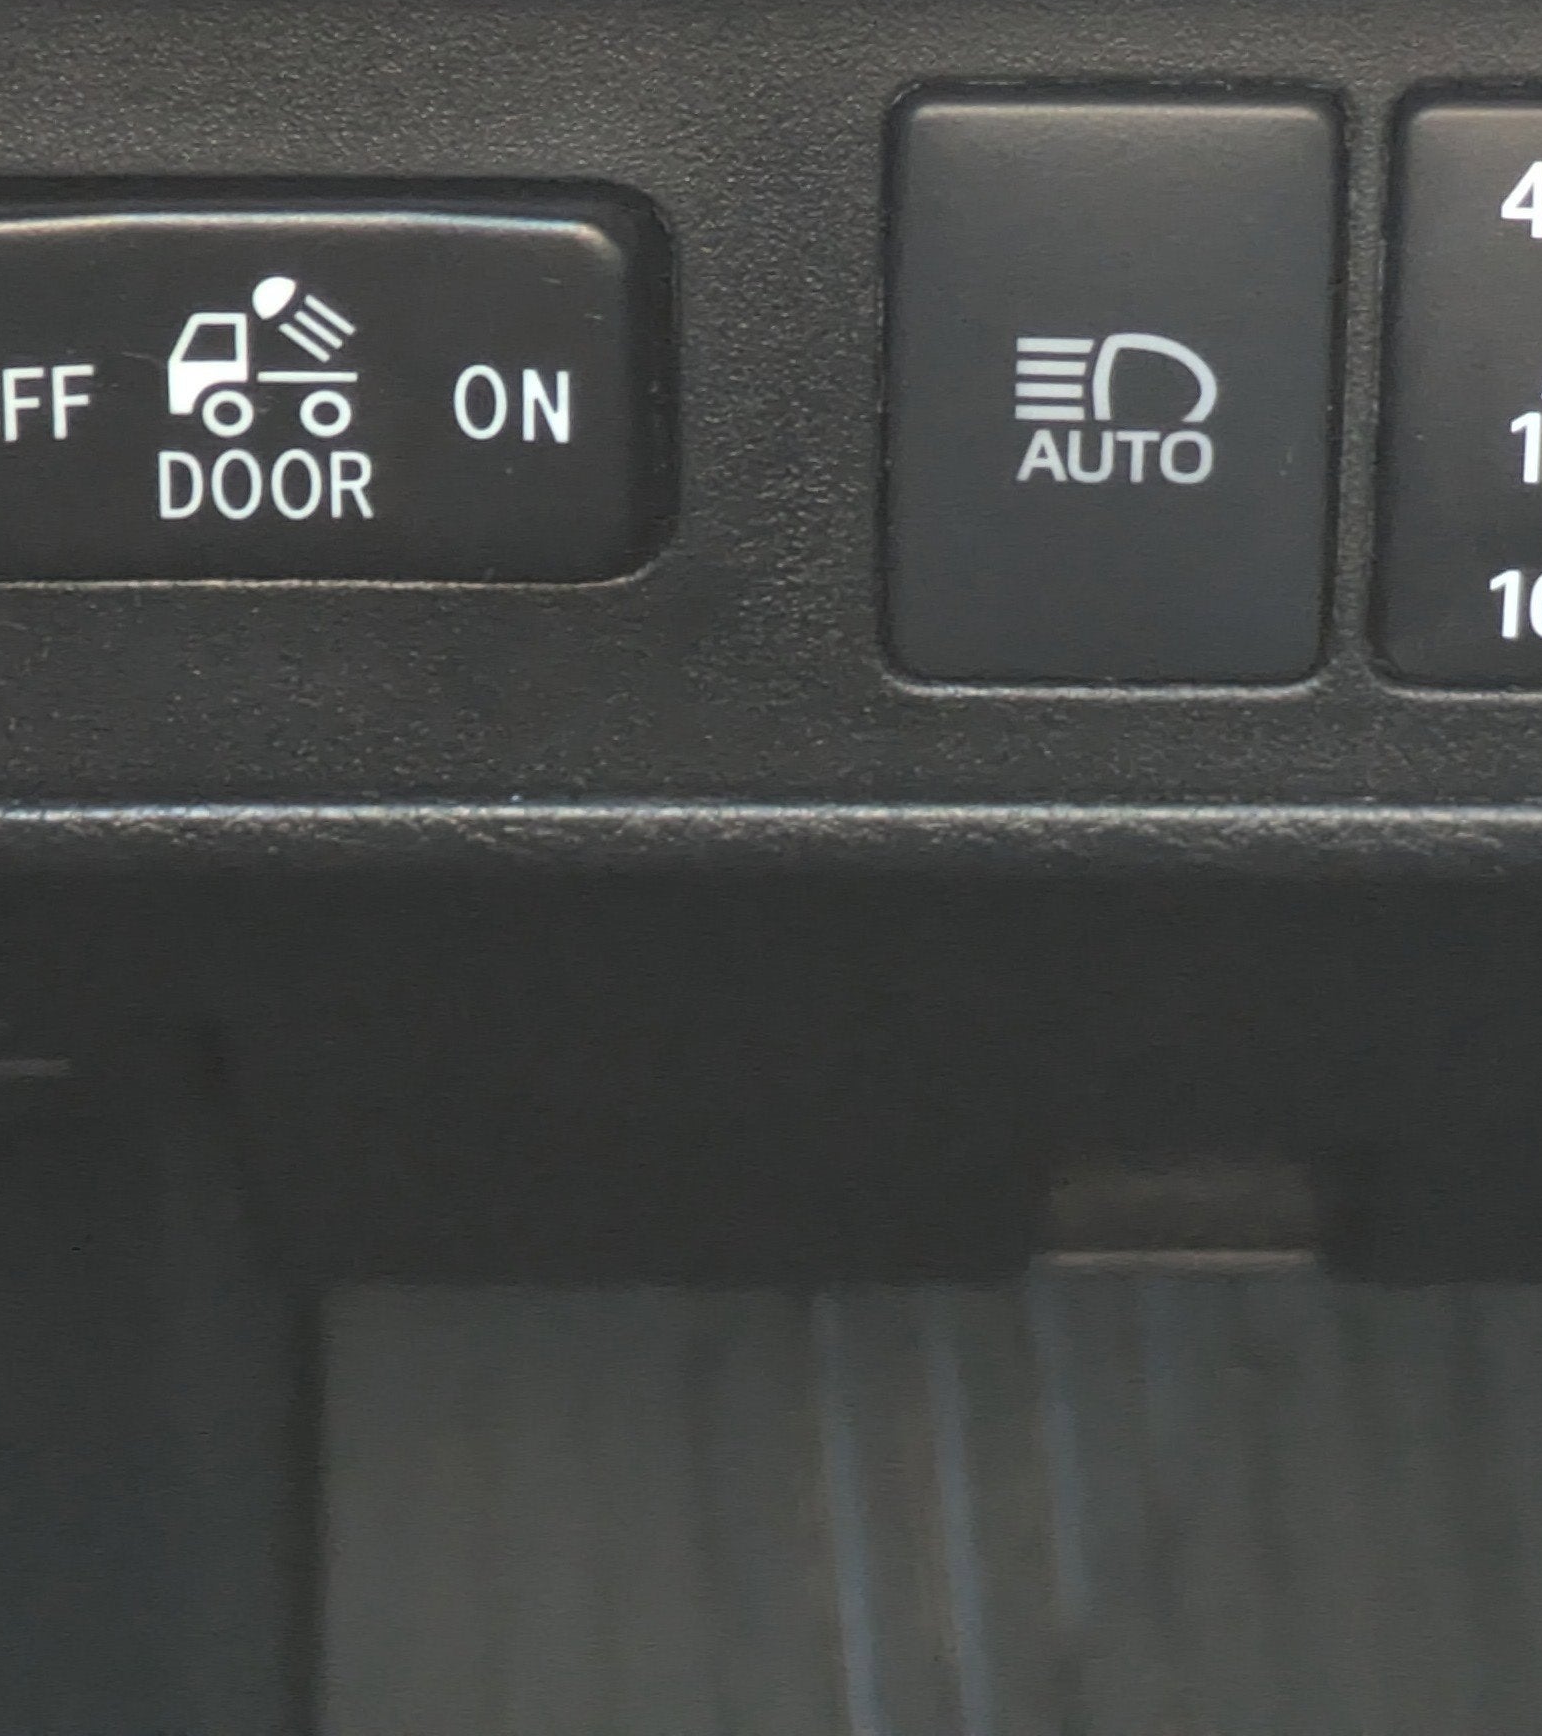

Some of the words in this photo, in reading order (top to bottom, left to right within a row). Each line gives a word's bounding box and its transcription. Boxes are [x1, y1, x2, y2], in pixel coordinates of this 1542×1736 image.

[452, 363, 572, 445] ON
[157, 447, 375, 521] DOOR
[1016, 428, 1214, 486] AUTO
